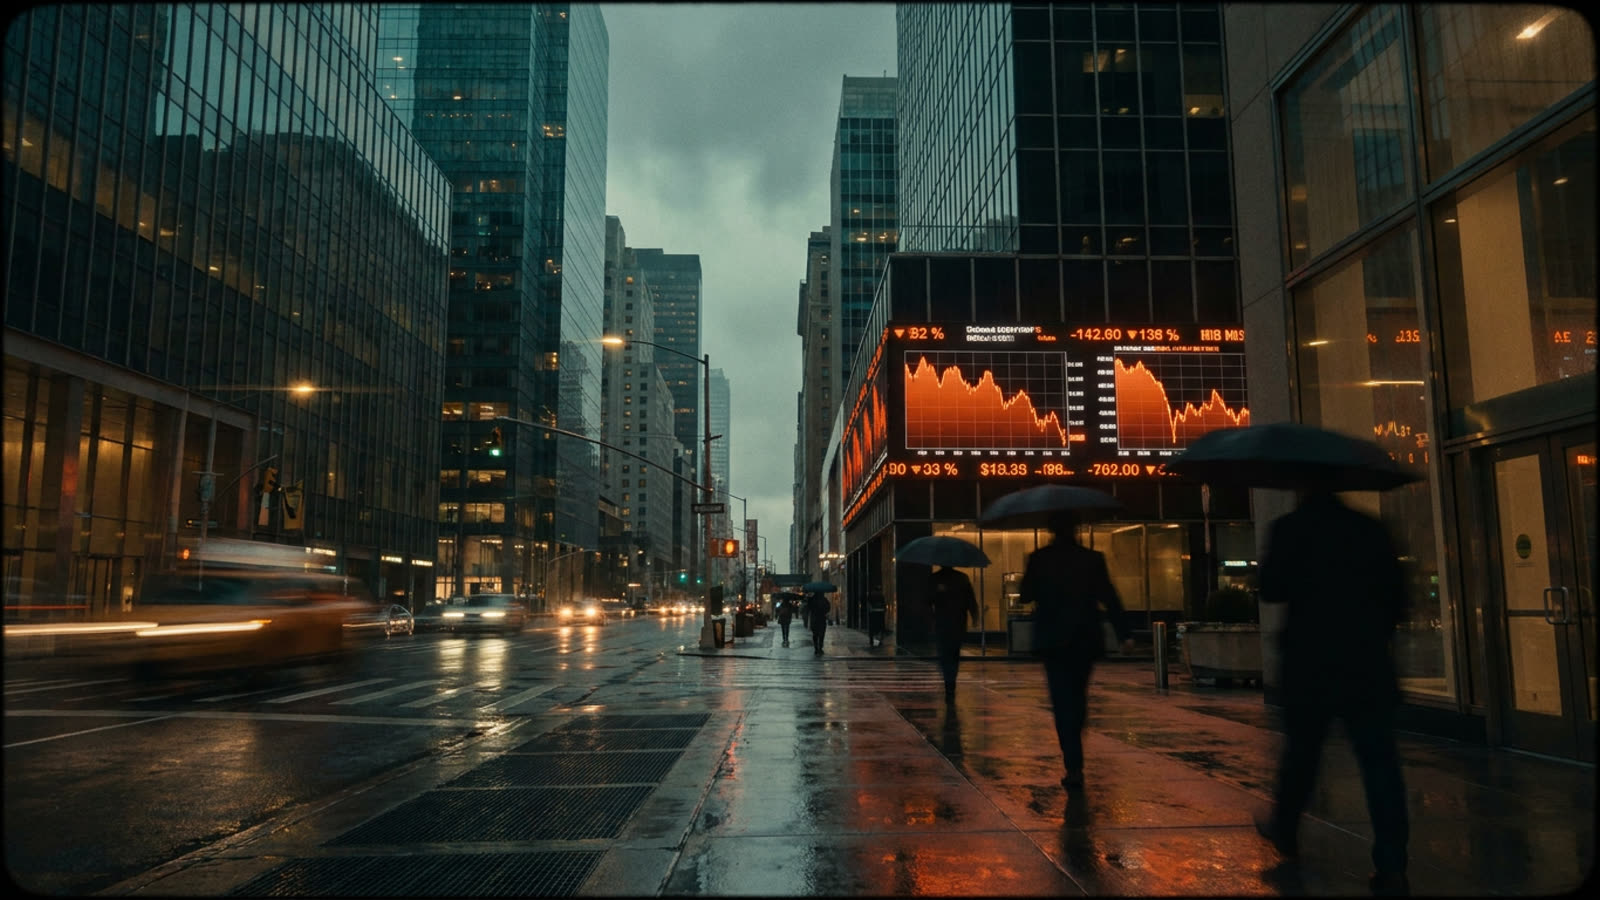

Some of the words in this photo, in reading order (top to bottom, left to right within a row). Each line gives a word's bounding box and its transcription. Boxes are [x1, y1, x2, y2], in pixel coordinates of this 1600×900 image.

[930, 327, 945, 340] %
[1070, 328, 1122, 341] -142.60
[943, 463, 959, 476] %
[1087, 463, 1140, 476] -762.00
